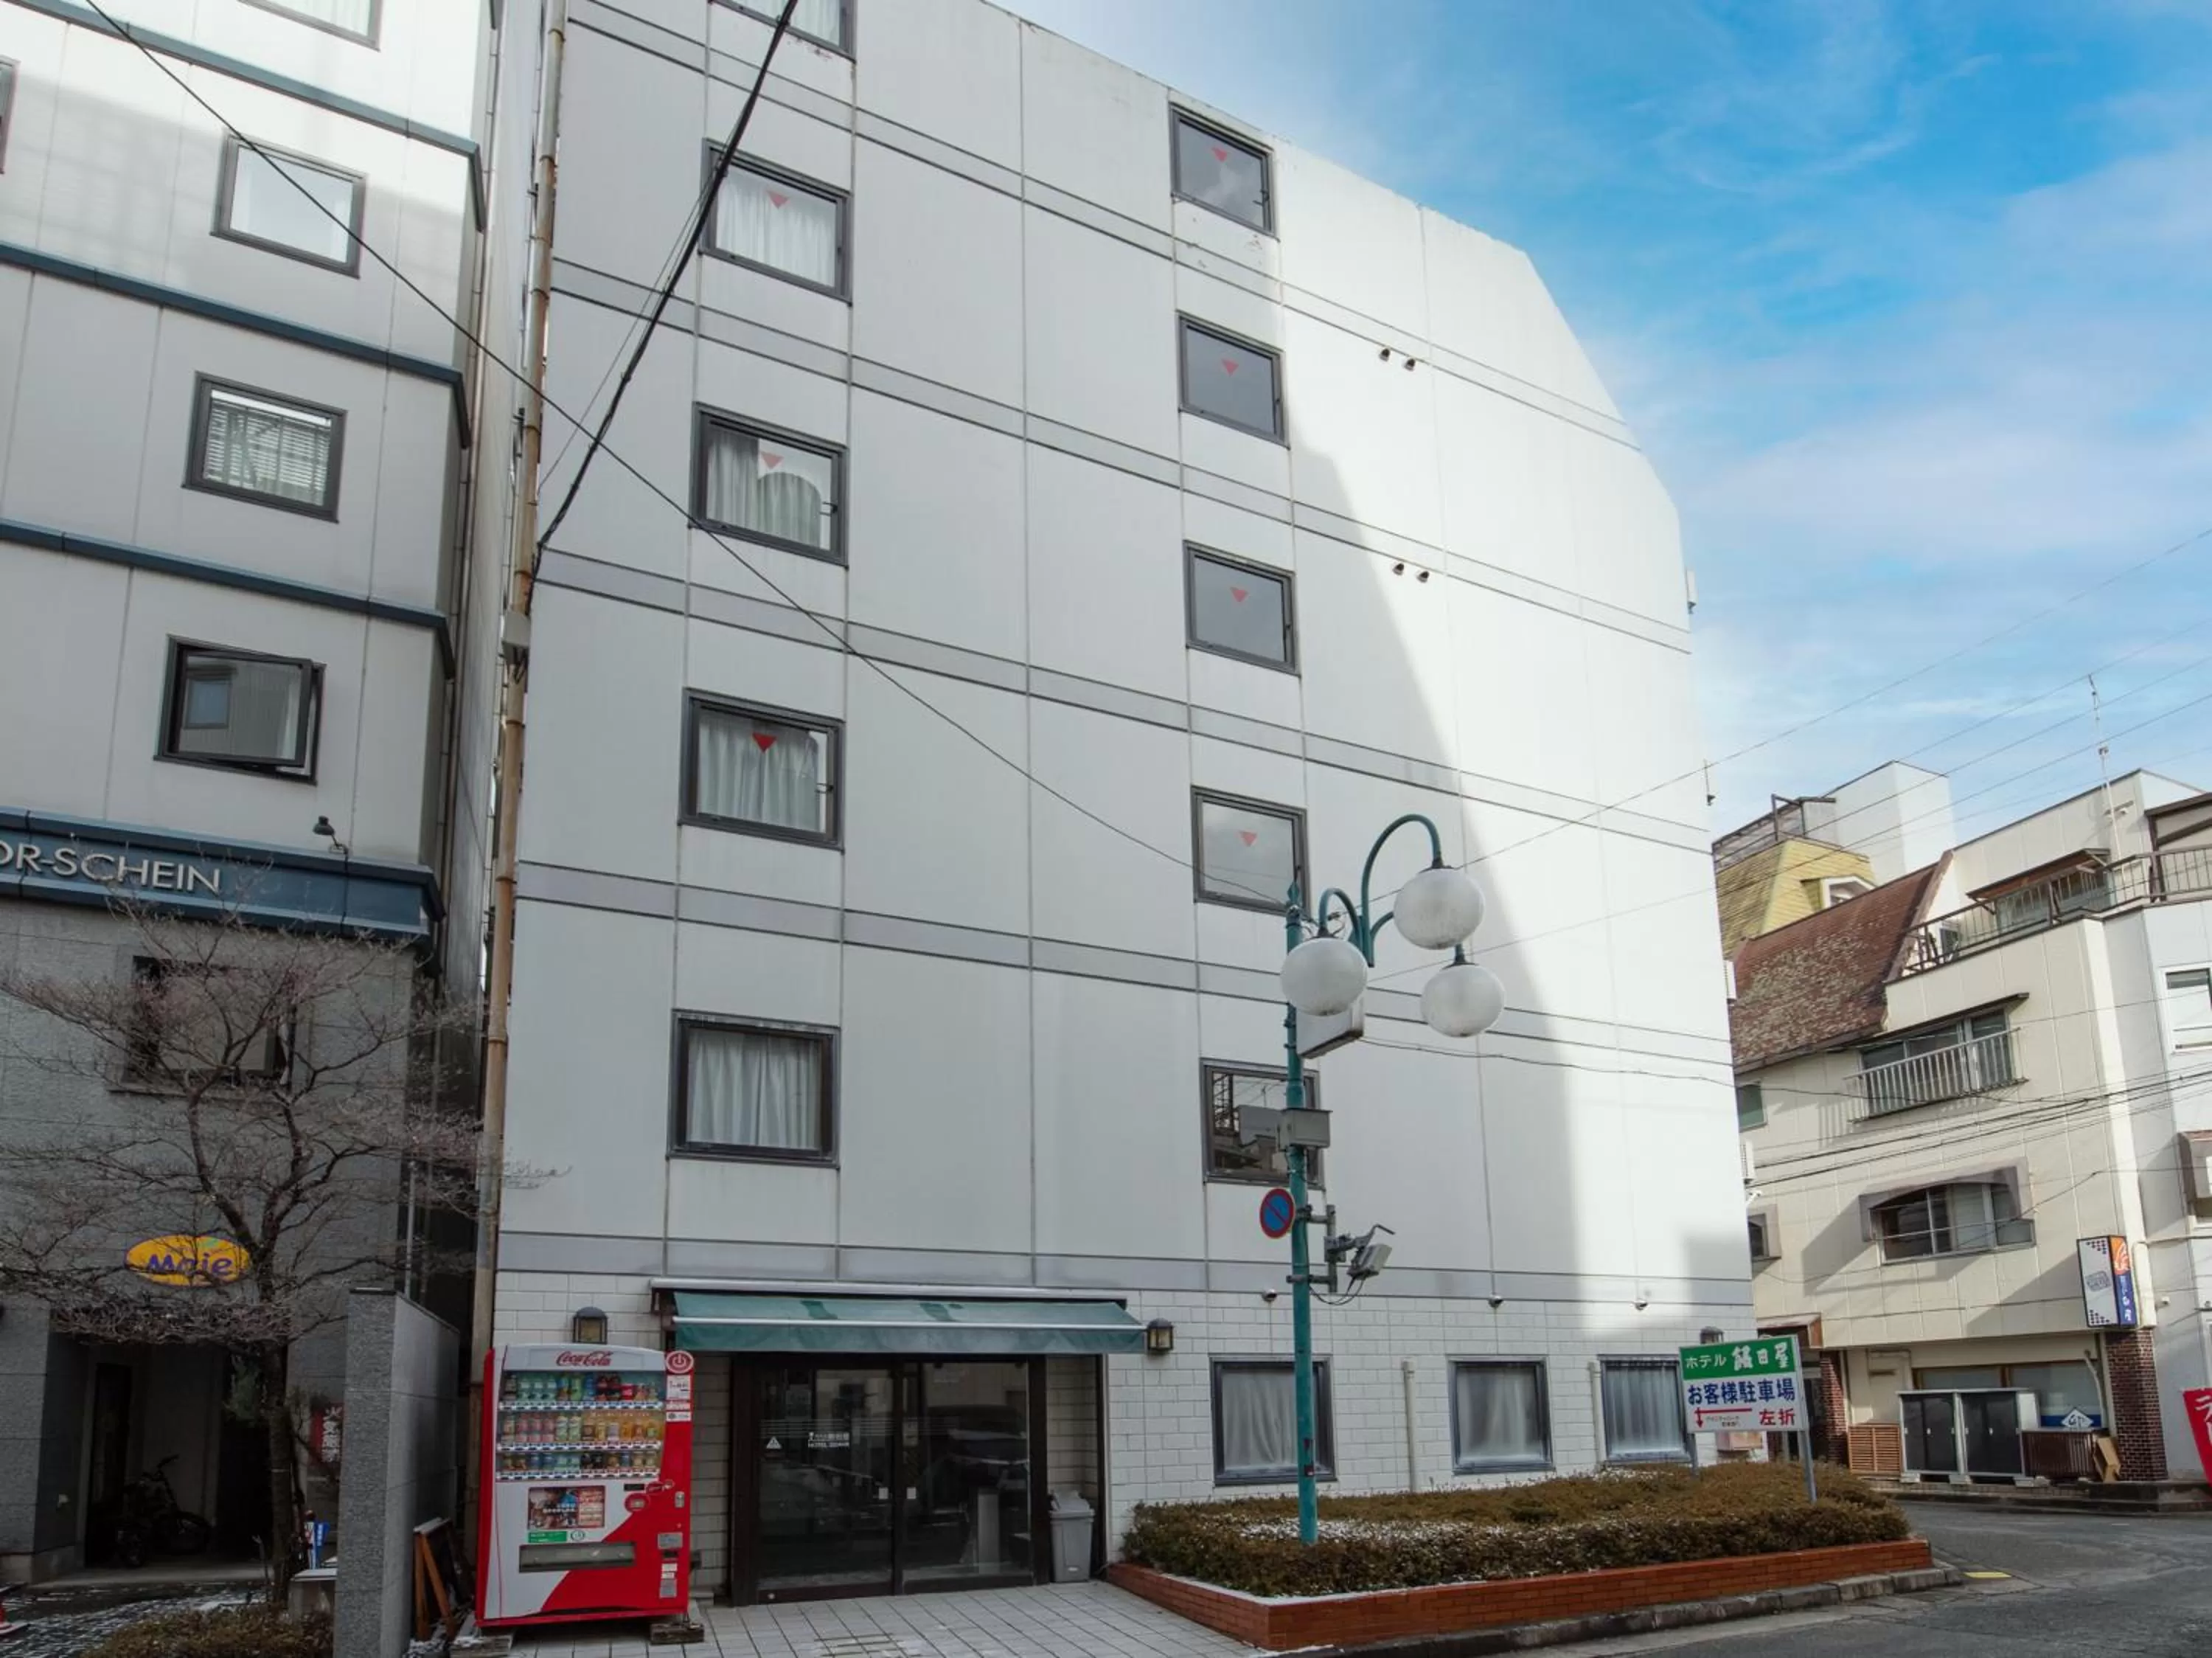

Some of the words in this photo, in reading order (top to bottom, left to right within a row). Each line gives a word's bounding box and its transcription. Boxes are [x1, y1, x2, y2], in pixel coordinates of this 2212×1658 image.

[1688, 1378, 1795, 1405] お客様駐車場
[1759, 1408, 1795, 1426] 左折
